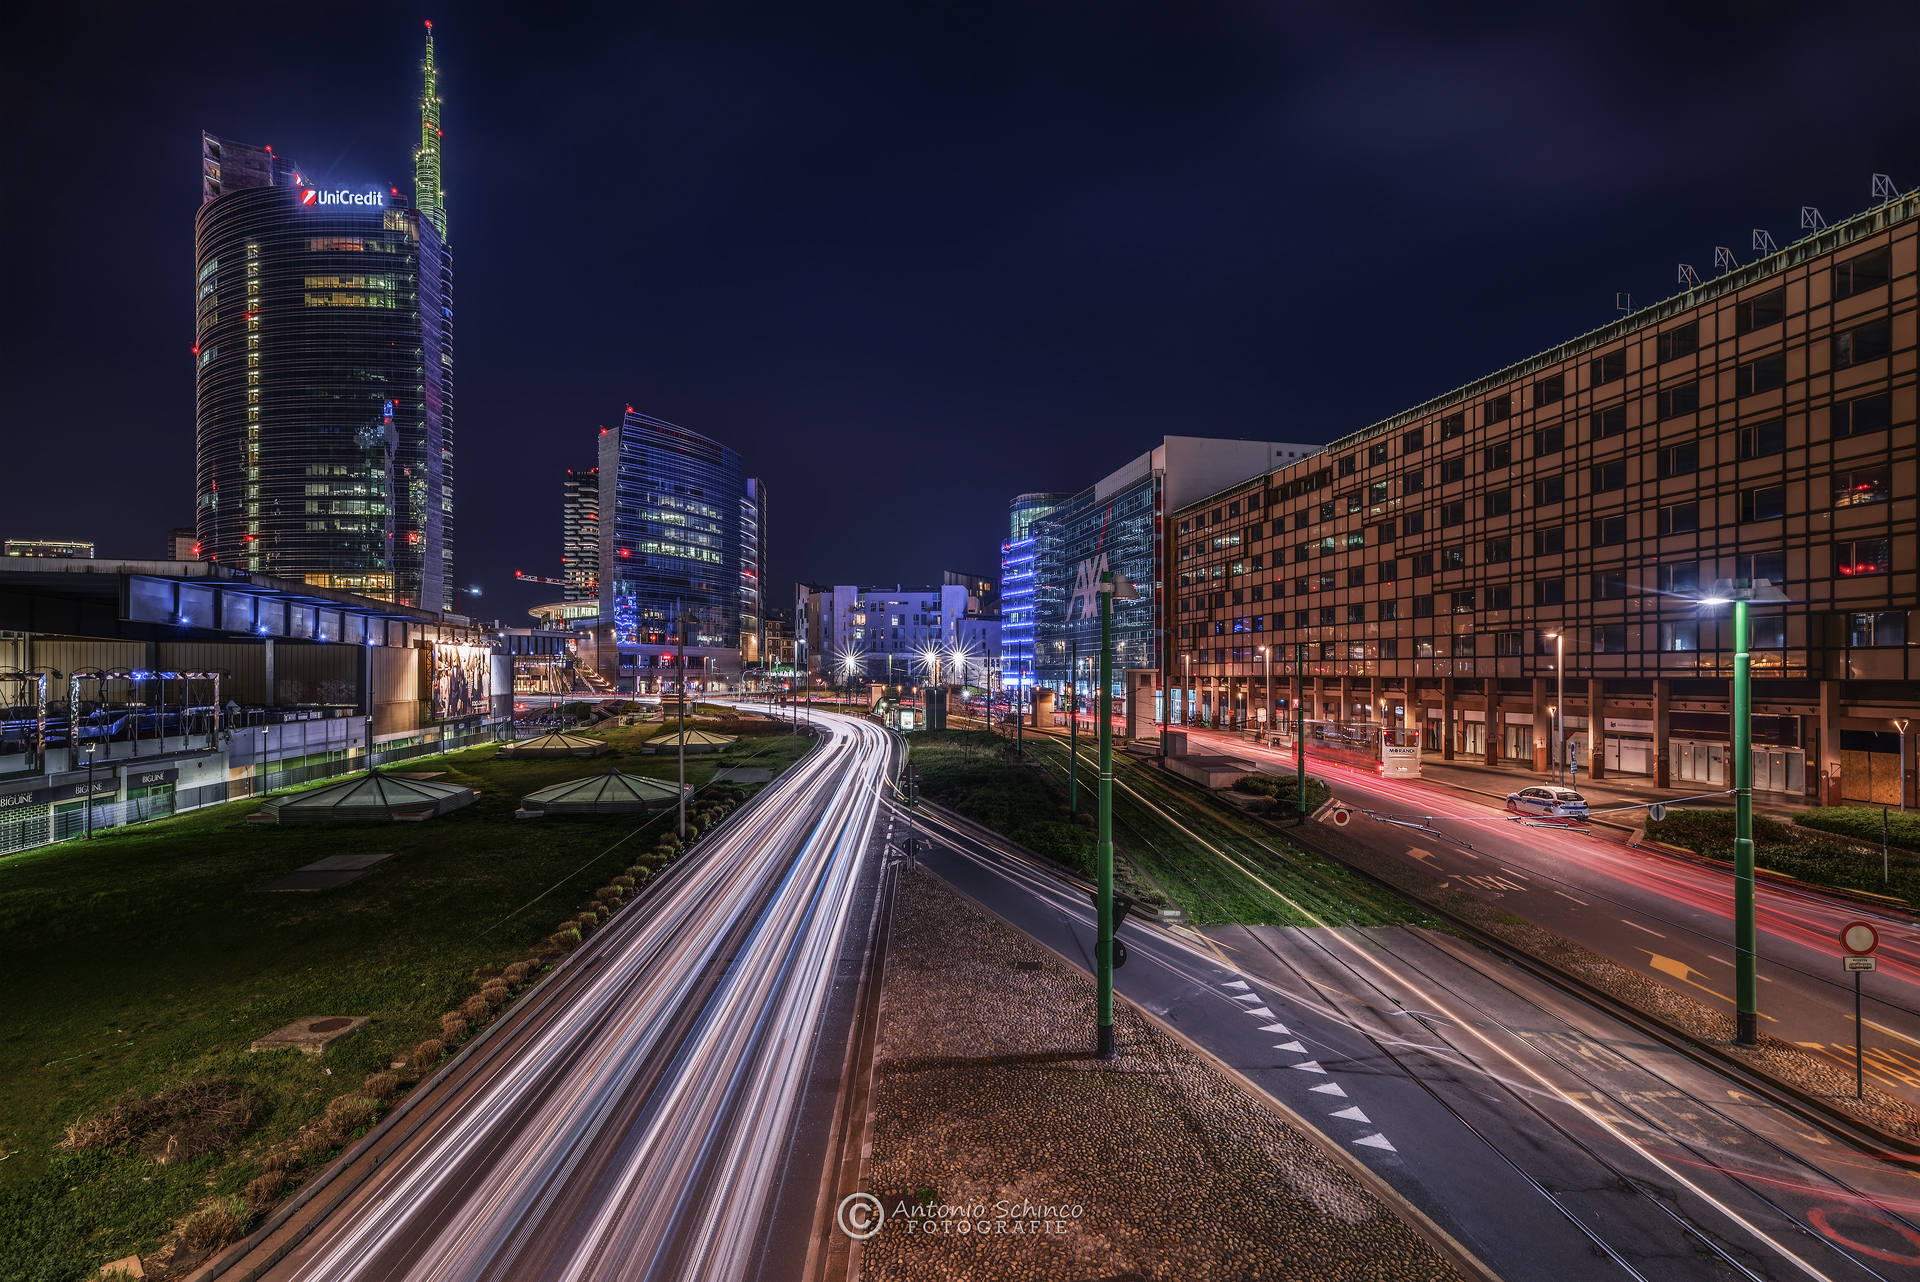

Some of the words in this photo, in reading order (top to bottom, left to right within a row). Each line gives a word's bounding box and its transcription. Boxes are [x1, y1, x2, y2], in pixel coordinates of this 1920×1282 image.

[318, 190, 383, 206] UniCredit
[1065, 552, 1114, 622] AXA
[0, 794, 33, 807] BIGUINE
[1447, 874, 1528, 892] TAXI
[1794, 1041, 1920, 1088] TAX
